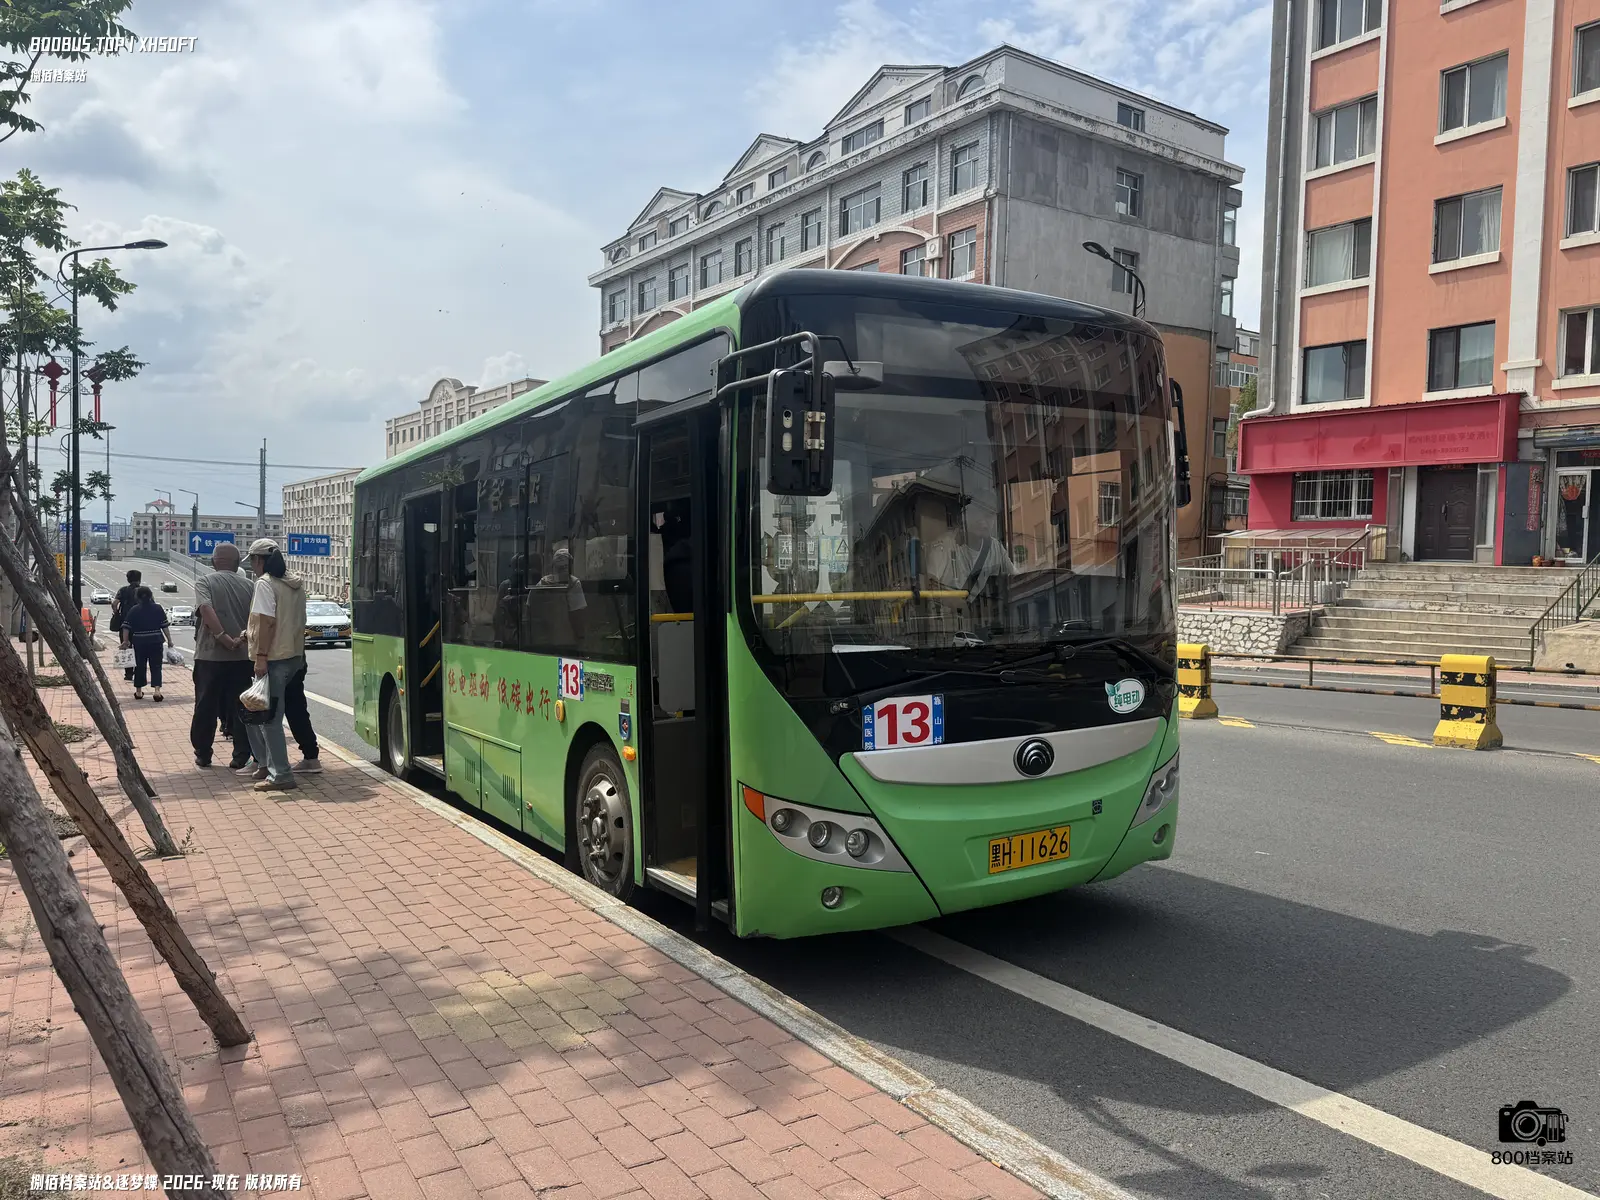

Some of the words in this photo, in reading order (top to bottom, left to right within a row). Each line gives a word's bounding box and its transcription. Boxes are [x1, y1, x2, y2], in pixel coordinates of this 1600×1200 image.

[562, 663, 579, 696] 13
[1111, 689, 1140, 708] 纯电动
[877, 701, 931, 746] 13
